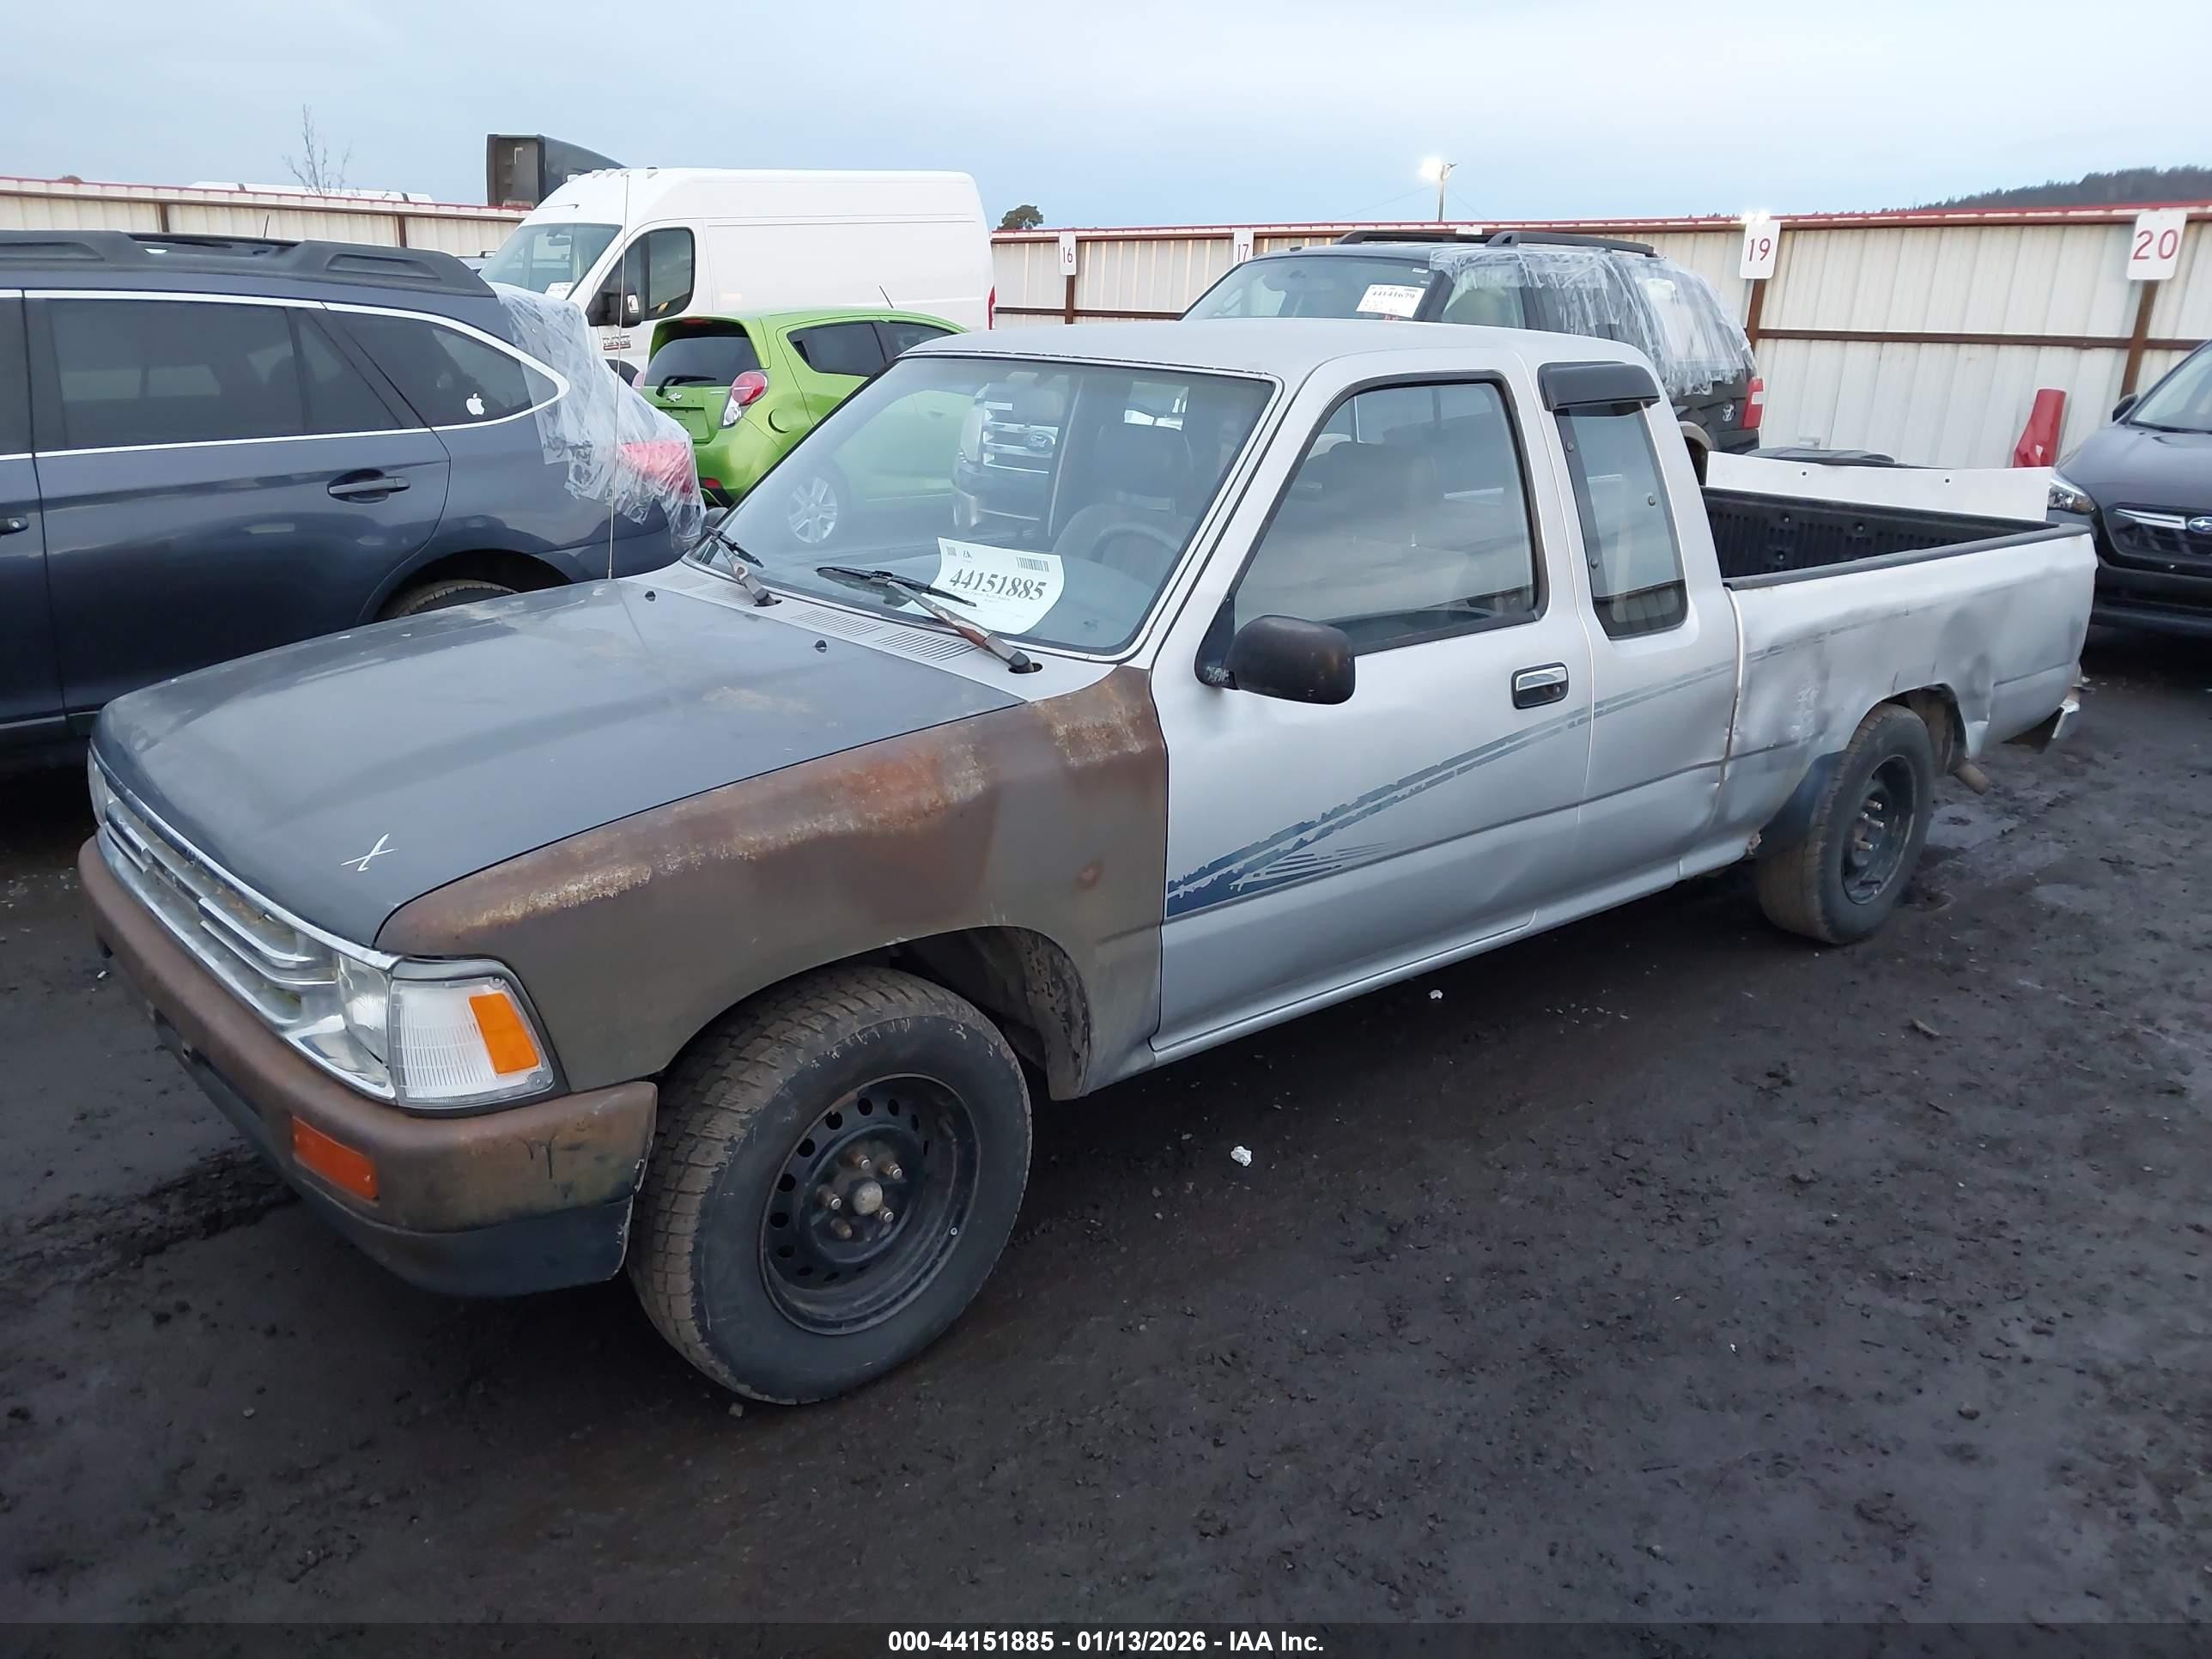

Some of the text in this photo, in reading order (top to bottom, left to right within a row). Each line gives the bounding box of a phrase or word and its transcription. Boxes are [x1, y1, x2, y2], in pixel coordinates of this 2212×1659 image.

[1062, 246, 1073, 264] 16
[1237, 243, 1249, 263] 17
[1748, 238, 1771, 262] 19
[2132, 229, 2179, 260] 20
[949, 568, 1048, 601] 44151885
